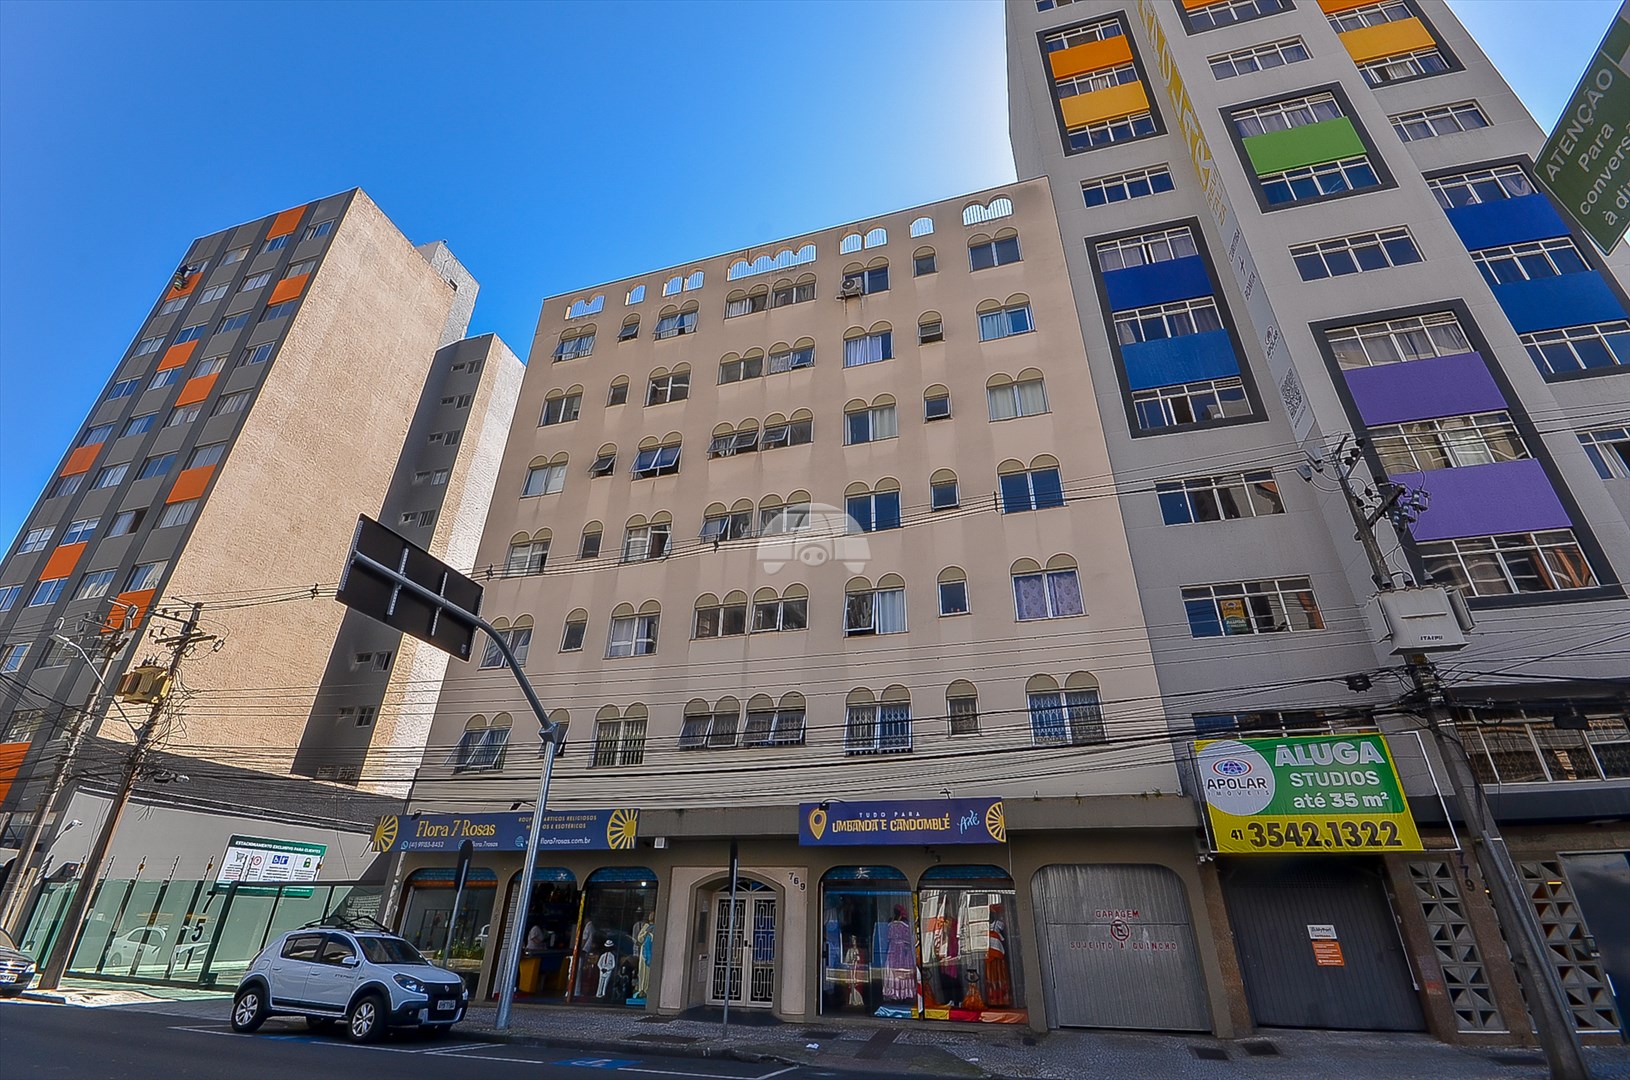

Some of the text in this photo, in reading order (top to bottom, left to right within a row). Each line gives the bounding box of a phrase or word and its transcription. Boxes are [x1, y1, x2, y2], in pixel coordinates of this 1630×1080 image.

[1545, 68, 1614, 182] ATENÇÃO
[1578, 123, 1614, 173] Para
[1580, 121, 1630, 215] convers
[1602, 210, 1618, 226] à
[1275, 741, 1385, 767] ALUGA
[1207, 777, 1268, 790] APOLAR
[1290, 770, 1380, 788] STUDIOS
[1293, 791, 1389, 809] até 35 m²
[415, 820, 496, 838] Flora 7 Rosas
[832, 813, 951, 833] UMBANDA E CANDOMBLÉ
[957, 810, 980, 834] Axé
[1230, 821, 1402, 848] 41 3542.1322
[235, 840, 272, 849] ESTACIONAMENTO
[788, 872, 806, 891] 769
[1095, 910, 1140, 918] GARAGEM
[1070, 941, 1113, 949] SUJEITO
[1133, 942, 1177, 950] GUINCHO
